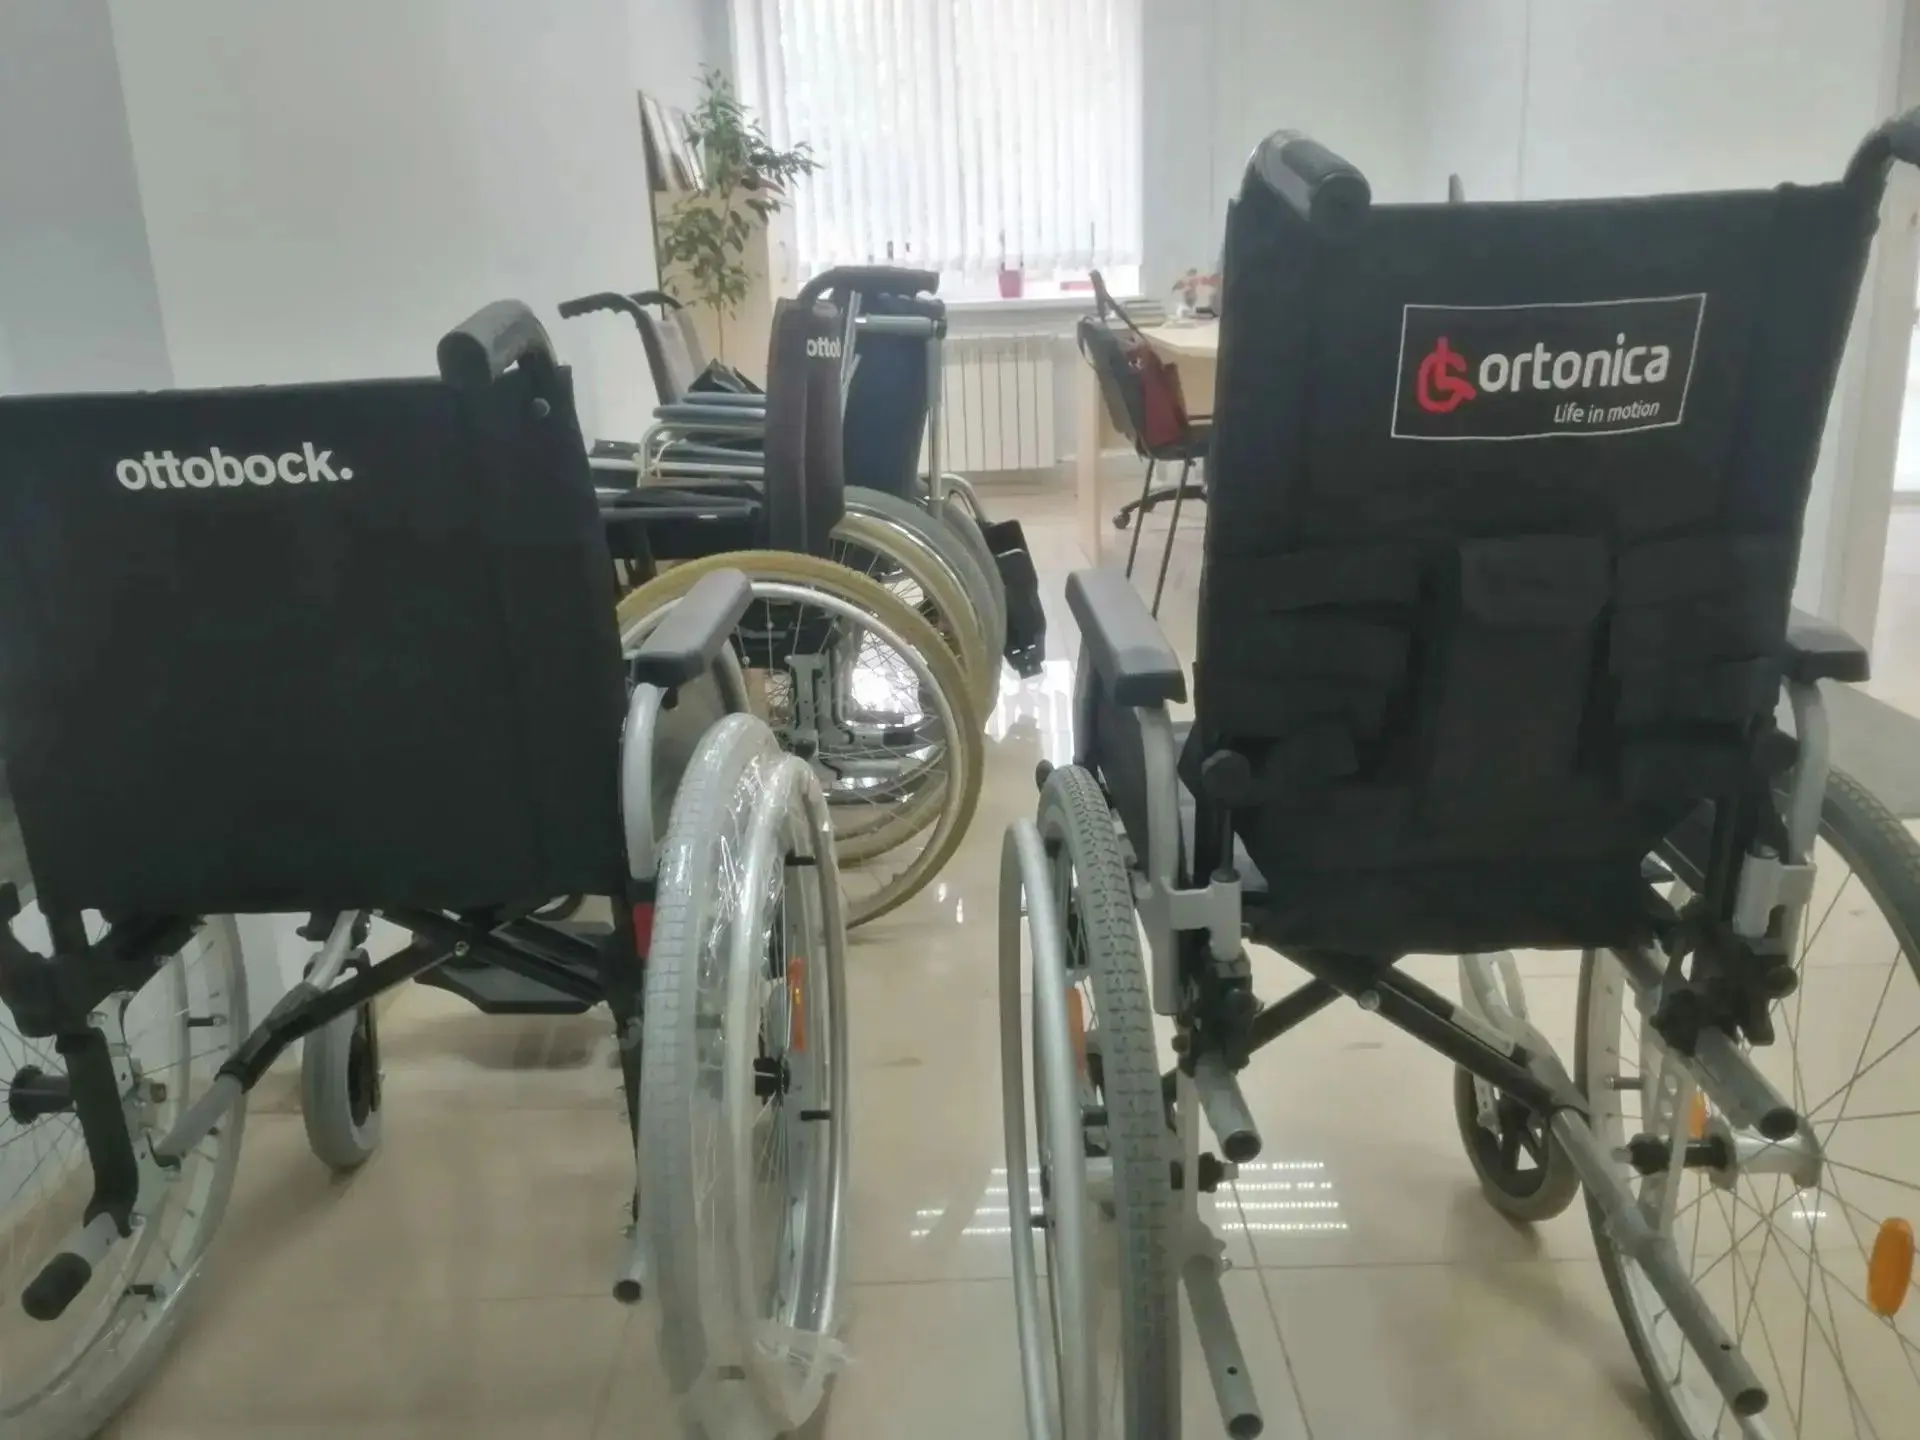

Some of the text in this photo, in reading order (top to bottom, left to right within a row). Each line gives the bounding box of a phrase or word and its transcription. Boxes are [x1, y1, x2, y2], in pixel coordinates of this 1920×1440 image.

[1479, 332, 1670, 392] ortonica
[1553, 400, 1661, 424] Life in motion
[116, 441, 354, 490] ottobock.
